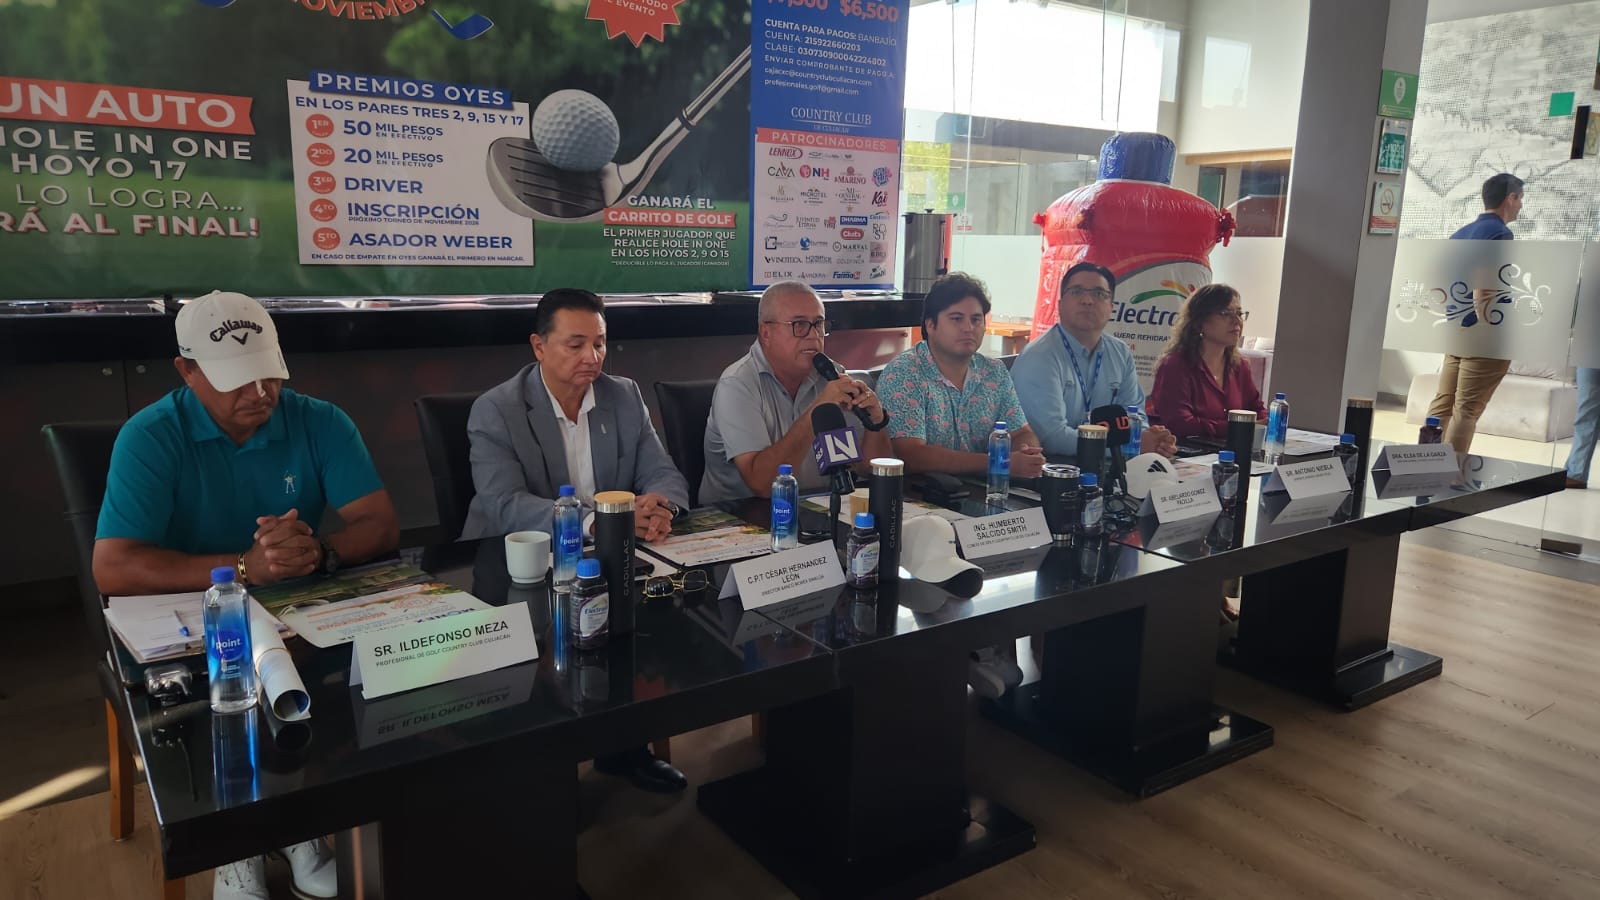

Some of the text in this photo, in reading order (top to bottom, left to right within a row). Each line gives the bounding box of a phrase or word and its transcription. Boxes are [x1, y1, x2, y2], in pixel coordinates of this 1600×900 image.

[616, 0, 655, 16] EVENTO
[765, 18, 800, 31] CUENTA
[802, 24, 825, 35] PARA
[827, 28, 857, 40] PAGOS:
[765, 54, 887, 78] ENVIAR COMPROBANTE DE PAGO
[317, 73, 505, 105] PREMIOS OYES
[86, 89, 236, 128] AUTO
[295, 96, 525, 126] EN LOS PARES TRES 2, 9, 15 Y 17
[791, 106, 872, 125] COUNTRY CLUB
[344, 120, 444, 136] 50 MIL PESOS
[0, 125, 253, 161] OLE IN ONE
[391, 133, 433, 141] EFECTIVO
[772, 131, 887, 151] PATROCINADORES
[344, 148, 372, 164] 20
[376, 151, 399, 160] MIL
[402, 152, 444, 163] PESOS
[11, 152, 186, 180] HOYO 17
[345, 177, 423, 194] DRIVER
[16, 184, 243, 211] LO LOGRA...
[628, 194, 715, 209] GANARÁ EL
[347, 203, 480, 220] INSCRIPCIÓN
[608, 211, 732, 225] CARRITO DE GOLF
[63, 212, 119, 234] AL
[133, 214, 260, 237] FINAL!
[349, 233, 513, 249] ASADOR WEBER
[603, 228, 736, 241] EL PRIMER JUGADOR QUE
[614, 239, 727, 249] REALICE HOLE IN ONE
[611, 249, 626, 257] EN
[629, 249, 650, 257] LOS
[652, 249, 689, 258] HOYOS
[691, 250, 699, 258] 2,
[701, 250, 708, 258] 9
[720, 250, 729, 258] 15
[210, 320, 263, 342] Callaway
[1137, 334, 1171, 342] REHIDRA
[973, 516, 1025, 533] ING. HUMBERTO
[977, 528, 1006, 540] SALCIDO
[1006, 525, 1027, 535] SMITH
[216, 638, 241, 650] point
[374, 620, 509, 657] SR. ILDEFONSO MEZA
[376, 654, 416, 667] PROFESIONAL
[442, 642, 468, 653] COUNTRY
[469, 639, 483, 647] CLUB
